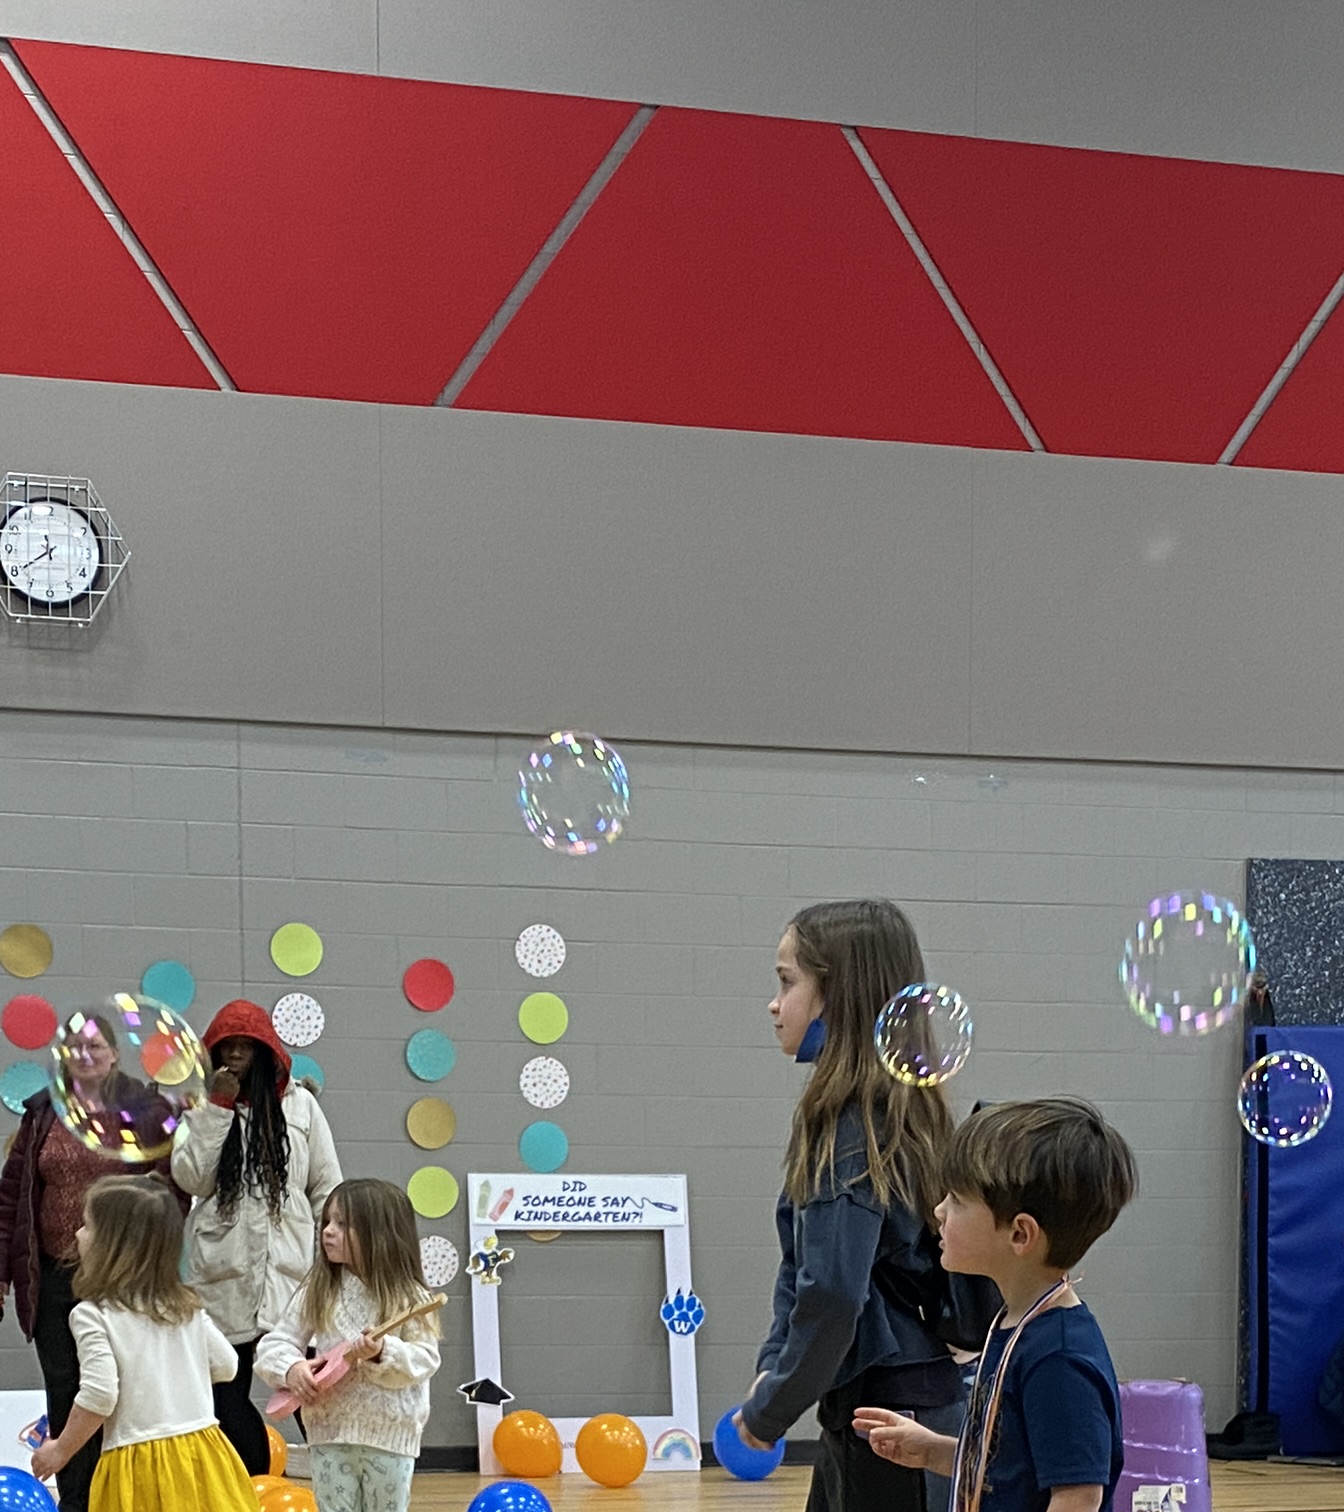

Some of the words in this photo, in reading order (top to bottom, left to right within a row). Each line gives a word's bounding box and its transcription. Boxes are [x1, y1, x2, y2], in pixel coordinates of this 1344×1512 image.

[5, 543, 13, 554] 9
[85, 548, 92, 560] 3
[10, 566, 19, 577] 8
[79, 567, 87, 578] 4
[45, 586, 54, 598] 6
[561, 1180, 588, 1192] DID
[522, 1195, 596, 1208] SOMEONE
[601, 1195, 631, 1208] SAY
[513, 1210, 644, 1224] KINDERGARTEN?!
[673, 1319, 691, 1334] W
